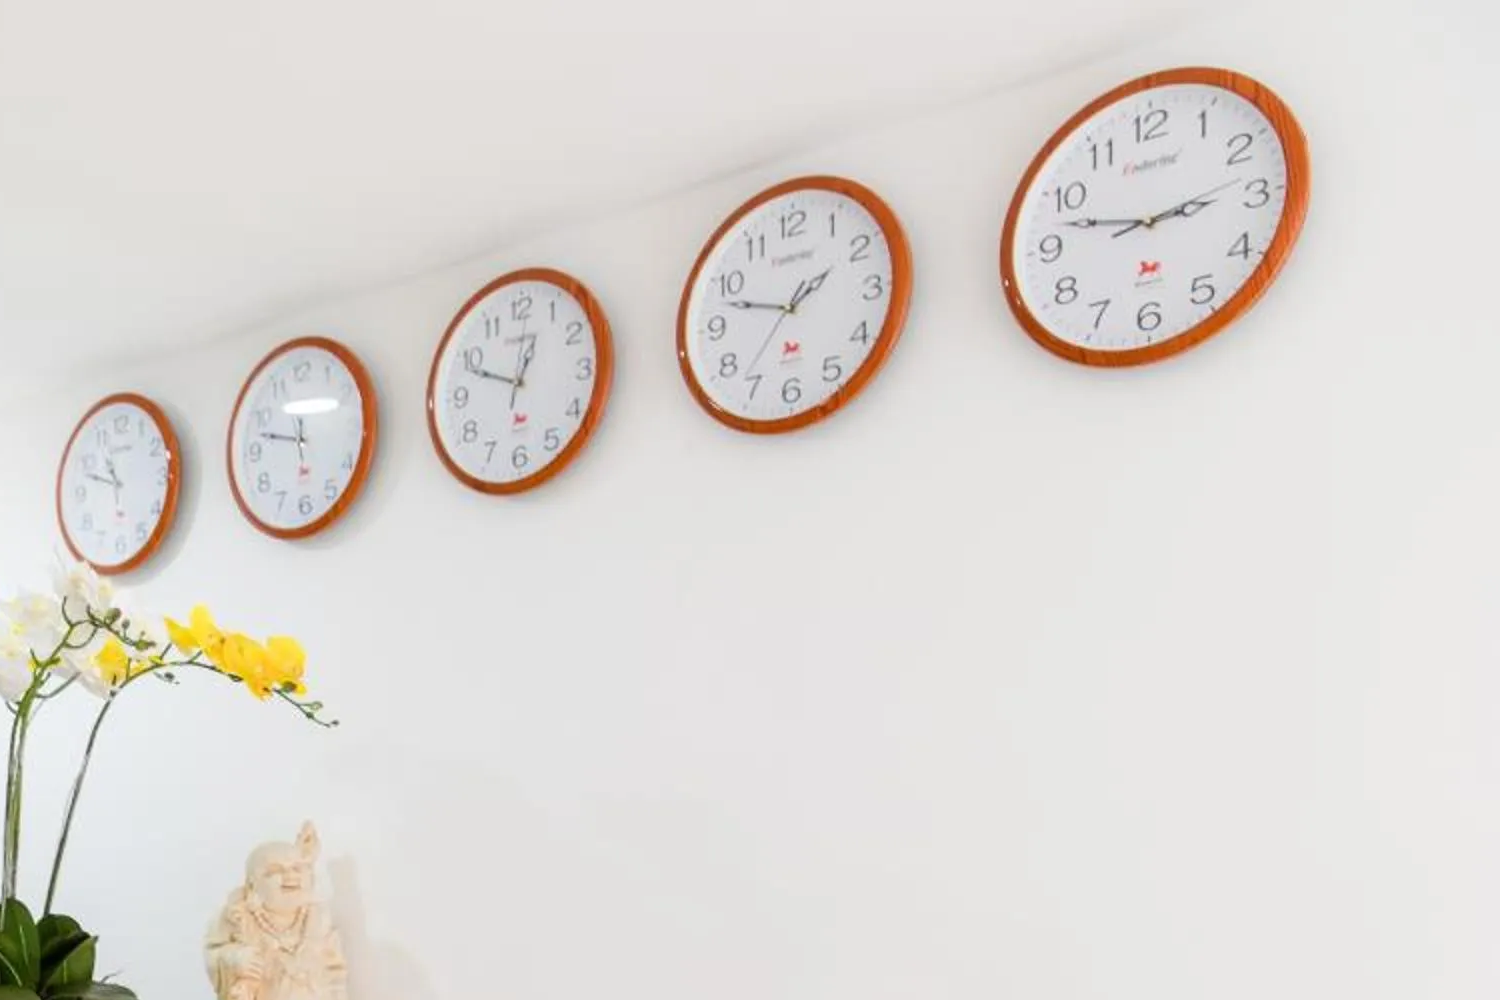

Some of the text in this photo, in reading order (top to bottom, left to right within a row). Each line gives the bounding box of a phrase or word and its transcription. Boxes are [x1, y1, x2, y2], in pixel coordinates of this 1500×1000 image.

[1134, 109, 1169, 144] 12
[1199, 110, 1207, 139] 1
[1089, 138, 1113, 170] 11
[1227, 133, 1253, 165] 2
[1054, 181, 1087, 213] 10
[1243, 179, 1269, 209] 3
[781, 211, 806, 239] 12
[829, 212, 835, 237] 1
[747, 234, 765, 261] 11
[850, 235, 870, 262] 2
[1039, 235, 1063, 263] 9
[1226, 232, 1253, 260] 4
[719, 270, 744, 298] 10
[862, 274, 883, 300] 3
[1055, 276, 1078, 304] 8
[1190, 274, 1215, 304] 5
[511, 297, 532, 321] 12
[549, 300, 556, 322] 1
[1089, 299, 1111, 329] 7
[1136, 302, 1162, 331] 6
[485, 316, 499, 339] 11
[565, 321, 583, 345] 2
[707, 315, 726, 341] 9
[850, 320, 869, 345] 4
[463, 347, 483, 371] 10
[576, 357, 592, 380] 3
[718, 353, 738, 379] 8
[822, 355, 842, 382] 5
[453, 387, 469, 409] 9
[745, 374, 763, 400] 7
[782, 377, 802, 404] 6
[565, 398, 580, 420] 4
[462, 420, 478, 443] 8
[543, 428, 560, 451] 5
[485, 441, 497, 464] 7
[512, 445, 528, 468] 6
